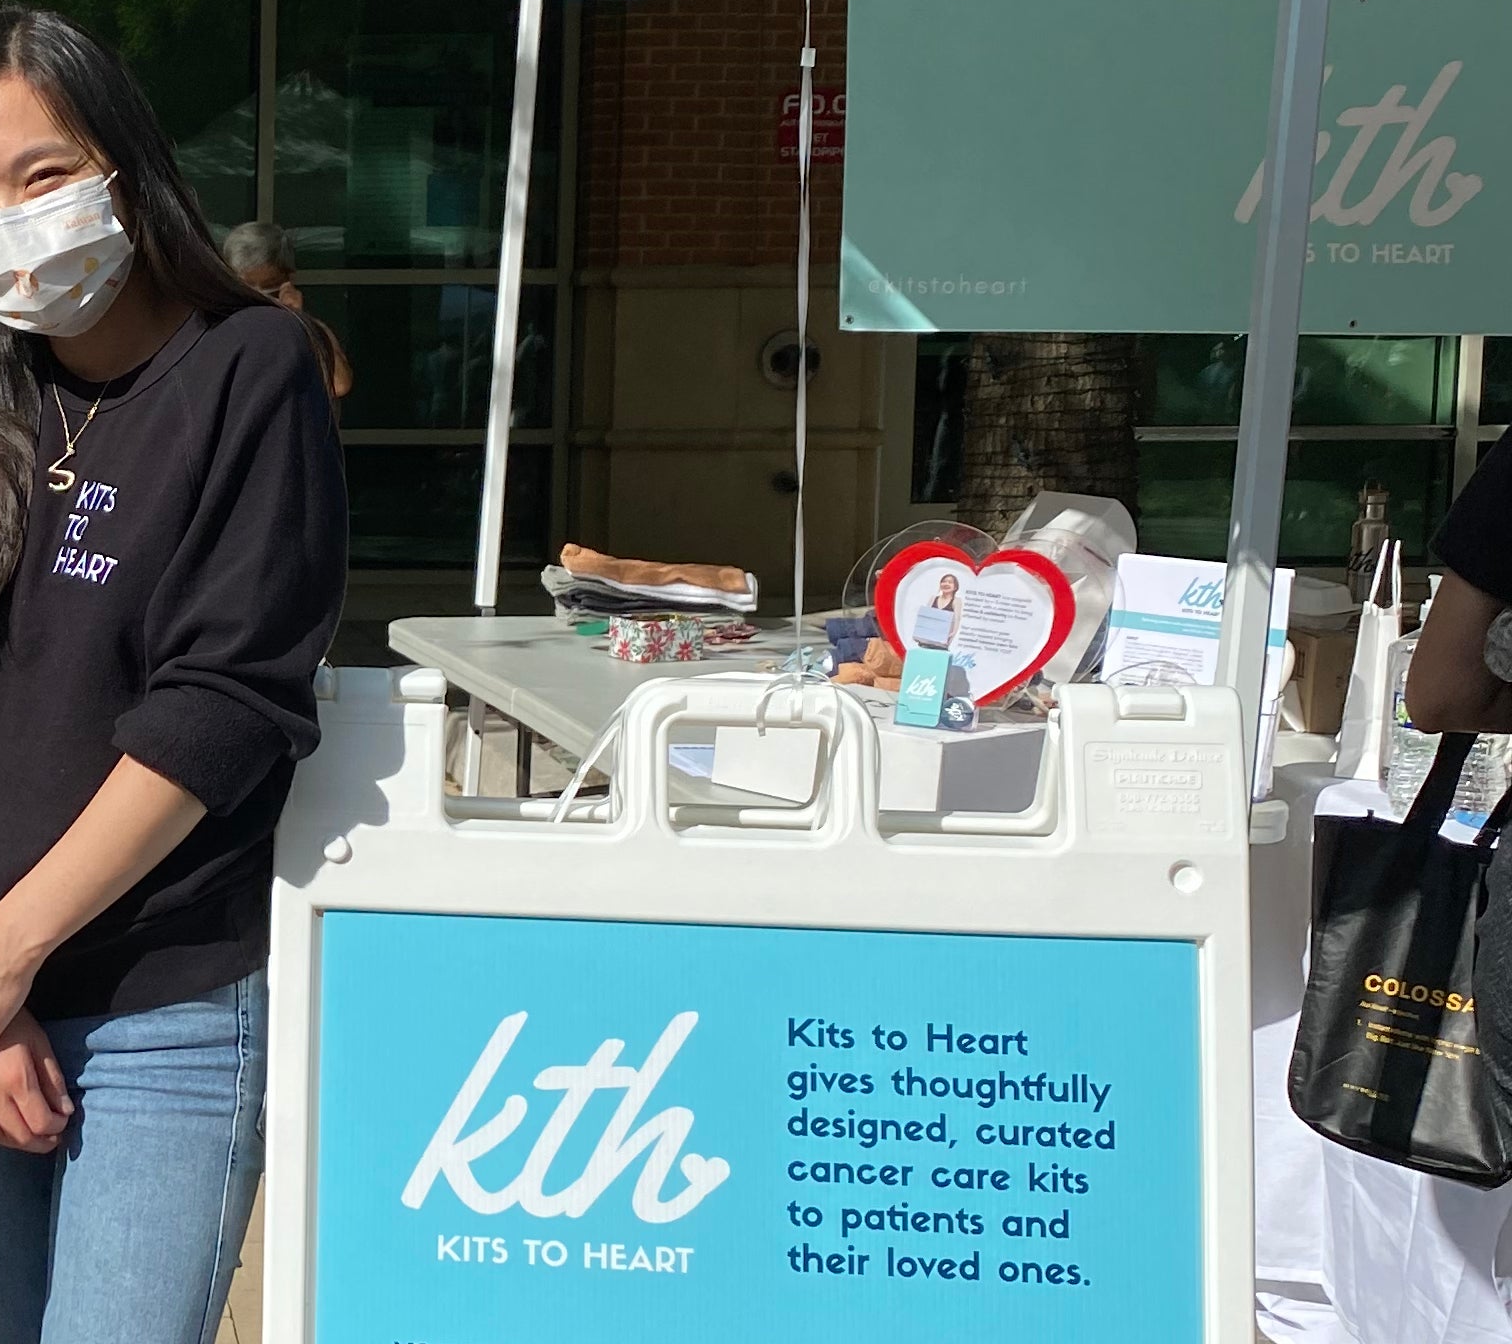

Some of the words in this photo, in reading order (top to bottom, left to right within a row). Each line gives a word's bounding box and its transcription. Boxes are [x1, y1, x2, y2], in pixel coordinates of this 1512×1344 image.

[1327, 242, 1360, 264] TO
[1371, 243, 1455, 265] HEART
[76, 480, 118, 513] KITS
[64, 514, 90, 541] TO
[52, 546, 119, 586] HEART
[788, 1017, 855, 1049] Kits
[871, 1024, 908, 1051] to
[927, 1022, 1029, 1057] Heart
[787, 1070, 875, 1101] gives
[890, 1066, 1113, 1113] thoughtfully
[401, 1010, 730, 1223] kth
[787, 1107, 958, 1150] designed,
[975, 1119, 1116, 1150] curated
[787, 1160, 914, 1187] cancer
[931, 1167, 1011, 1191] care
[1028, 1161, 1090, 1195] kits
[786, 1200, 823, 1228] to
[841, 1204, 985, 1239] patients
[1001, 1208, 1070, 1239] and
[437, 1234, 509, 1264] KITS
[522, 1239, 568, 1267] TO
[583, 1242, 695, 1274] HEART
[786, 1242, 870, 1276] their
[887, 1246, 980, 1281] loved
[998, 1261, 1091, 1287] ones.
